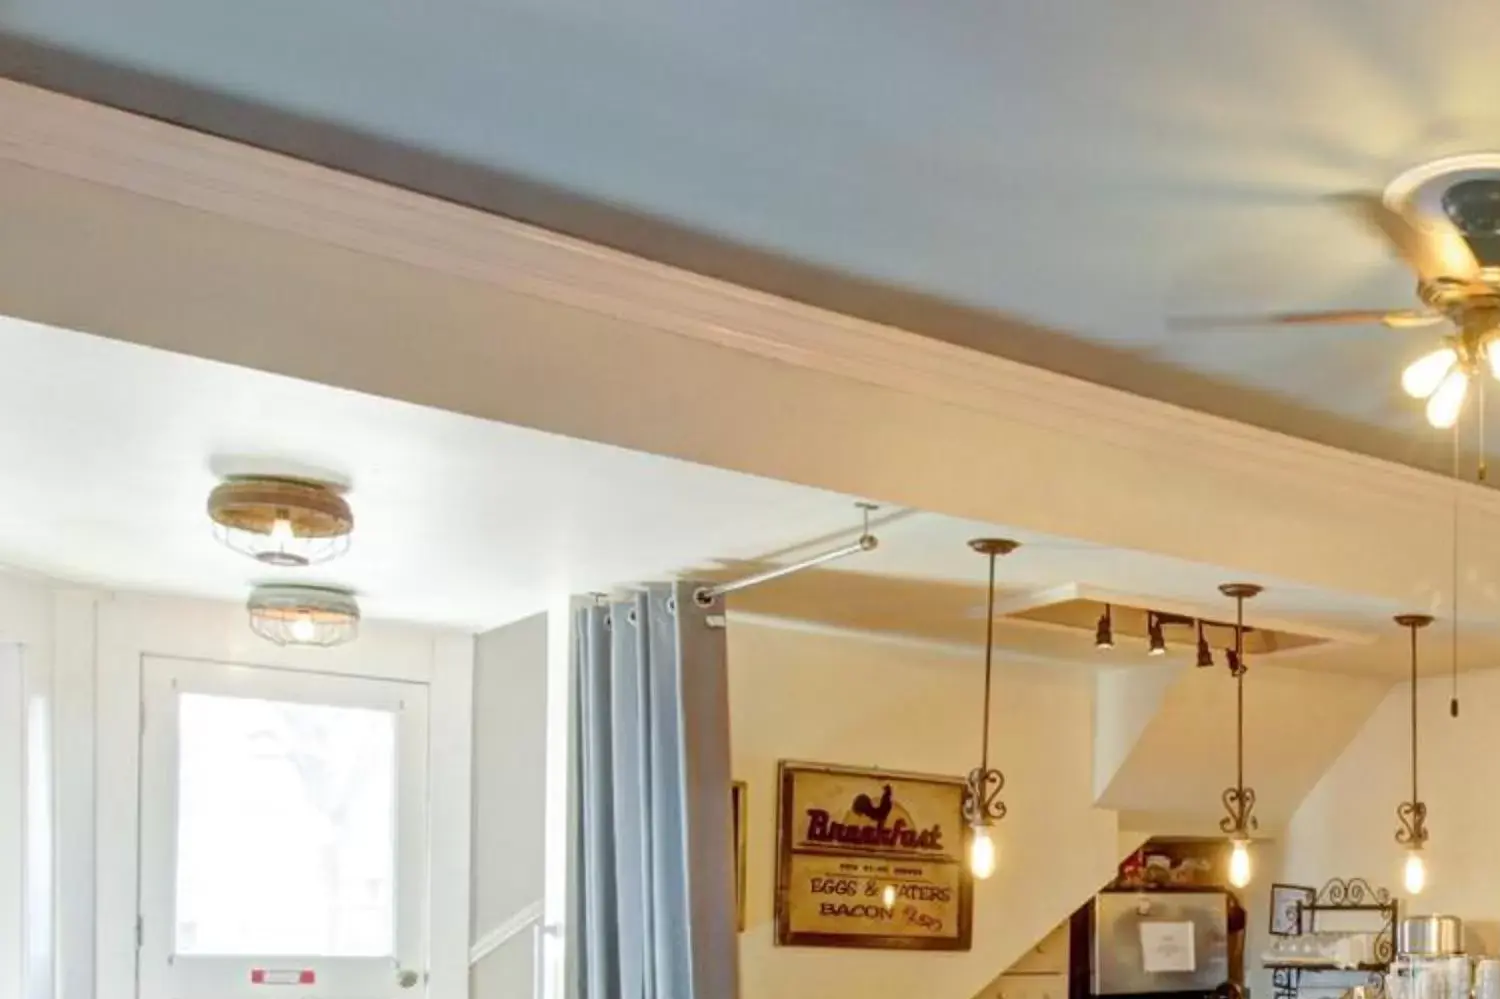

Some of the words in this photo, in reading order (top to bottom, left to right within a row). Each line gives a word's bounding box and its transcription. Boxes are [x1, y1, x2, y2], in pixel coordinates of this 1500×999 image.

[807, 808, 942, 850] Breakfast
[811, 878, 857, 896] EGGS
[864, 878, 878, 898] &
[888, 884, 951, 903] ATERS
[820, 902, 895, 921] BACON
